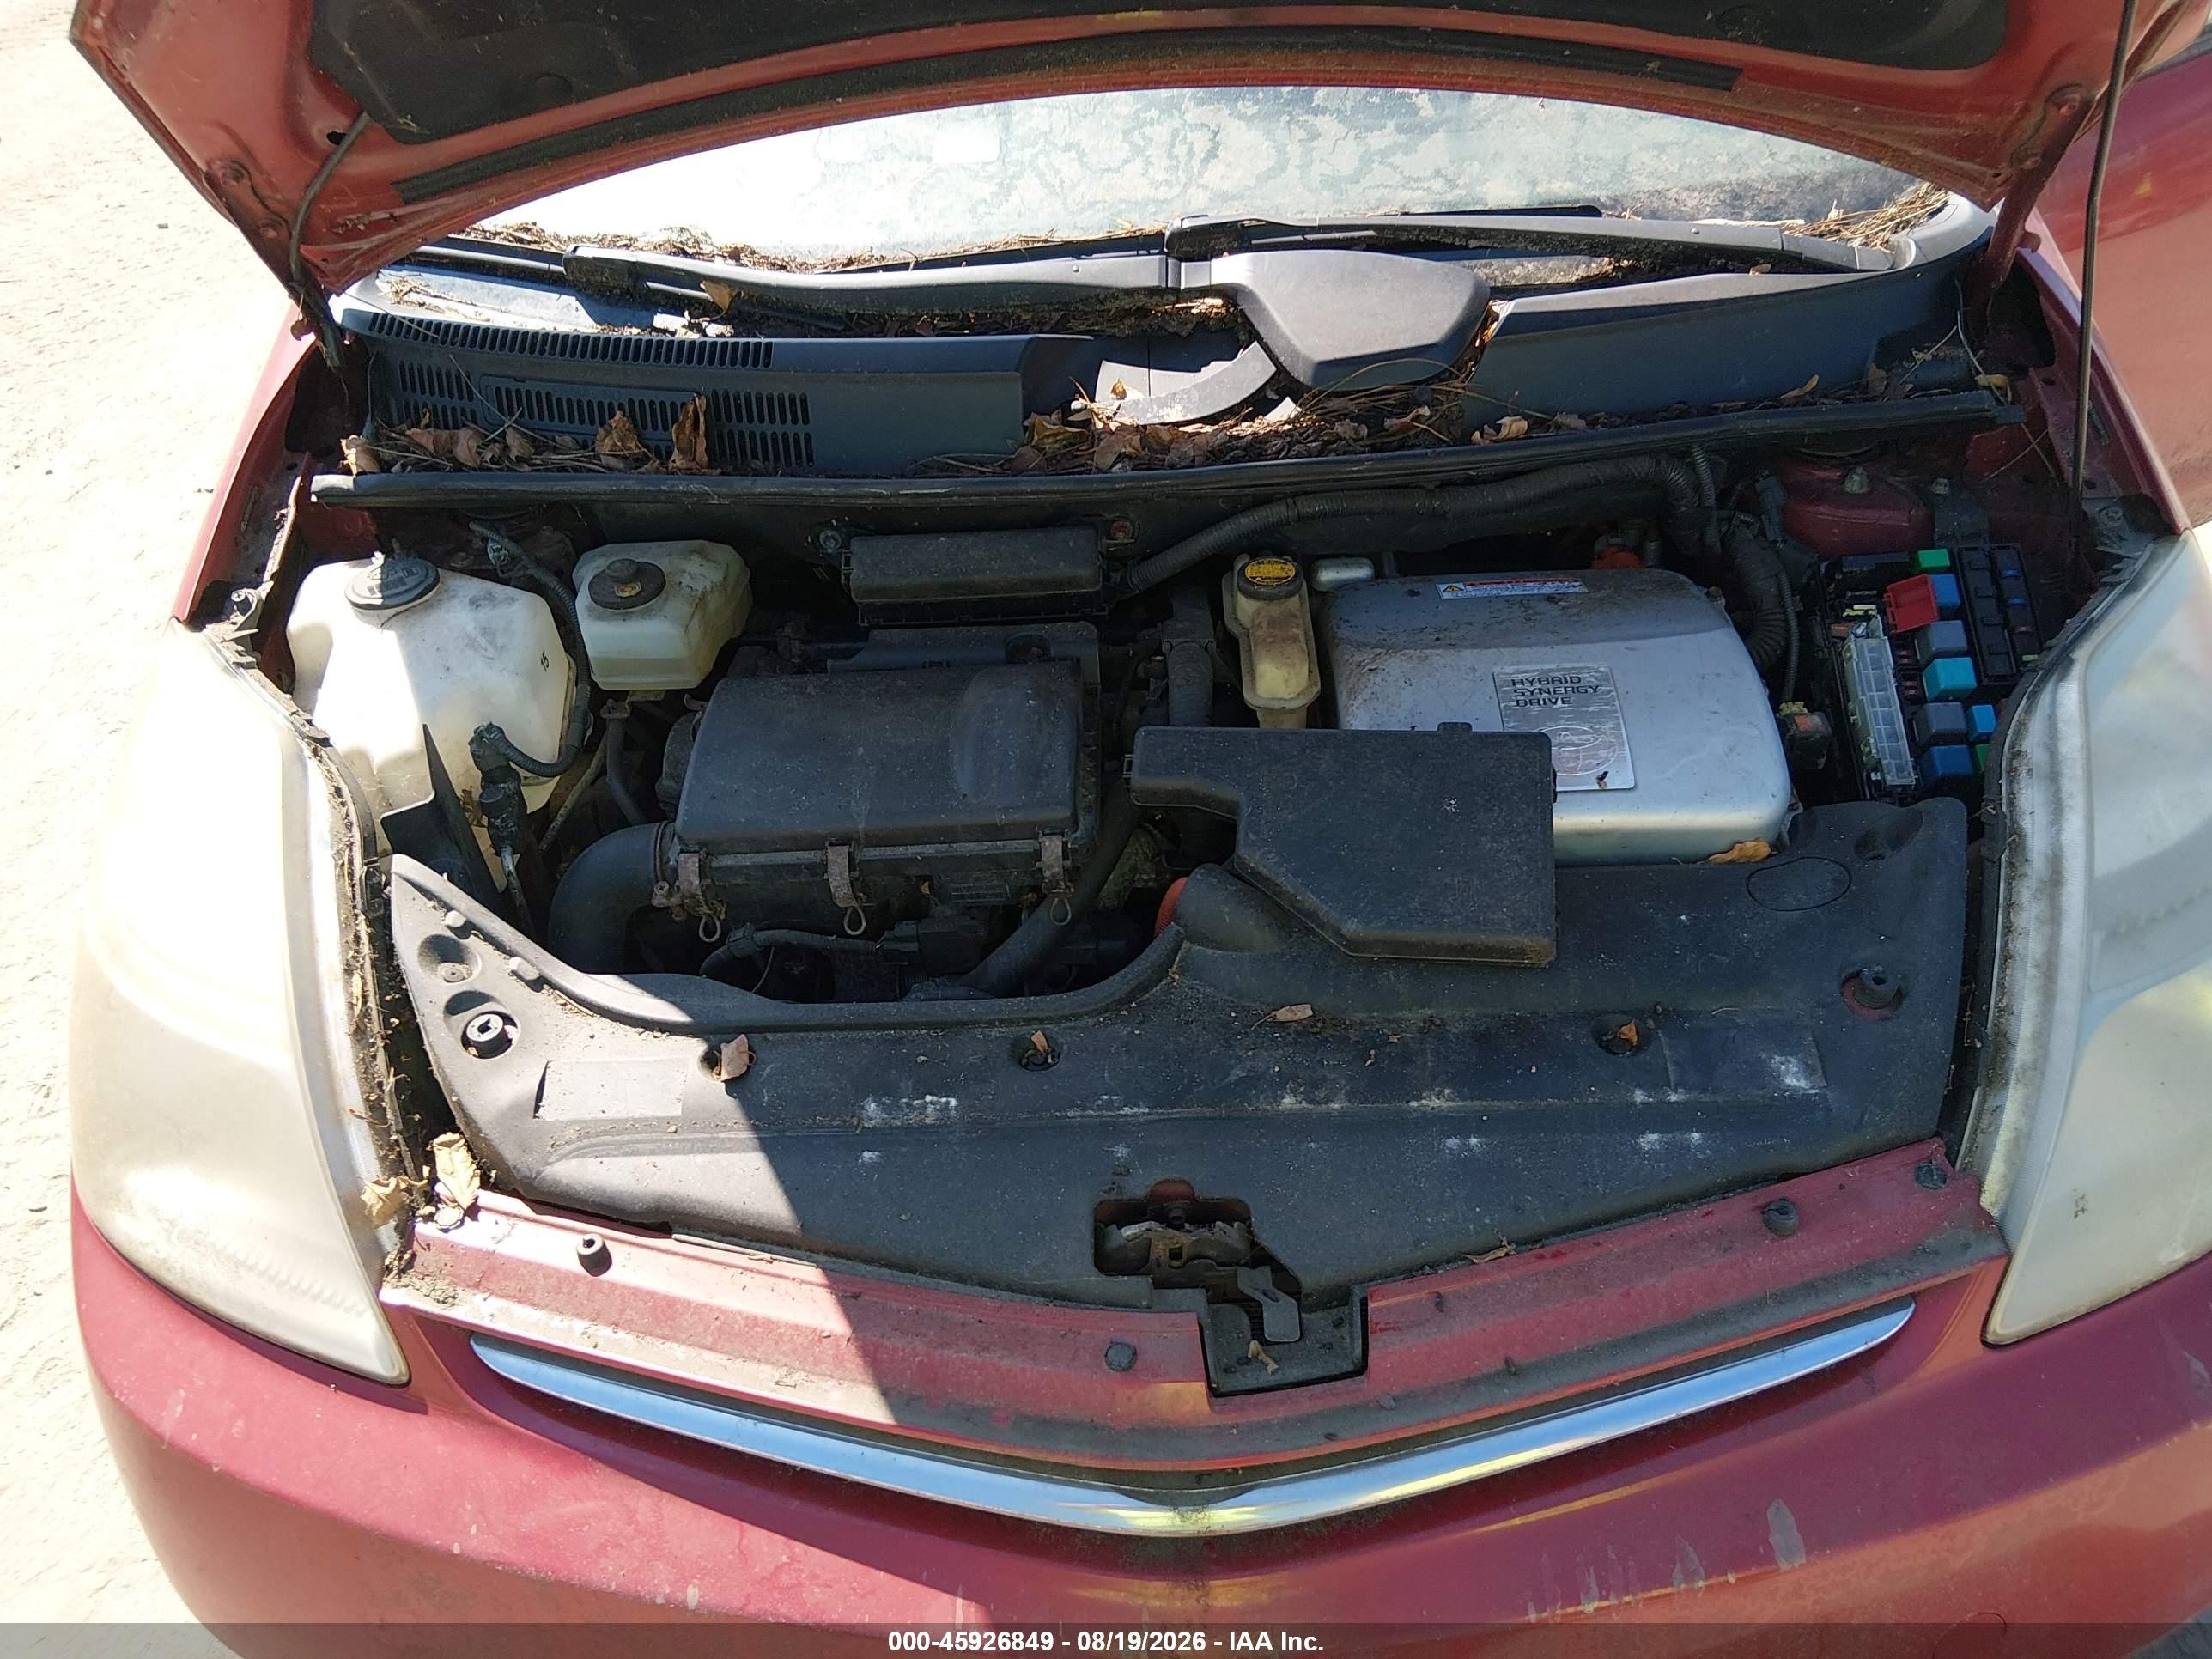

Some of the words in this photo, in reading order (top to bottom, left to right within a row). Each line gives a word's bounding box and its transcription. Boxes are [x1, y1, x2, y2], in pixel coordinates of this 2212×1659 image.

[1511, 676, 1582, 687] HYBRID
[1514, 685, 1599, 697] SYNERGY
[1516, 696, 1572, 708] DRIVE
